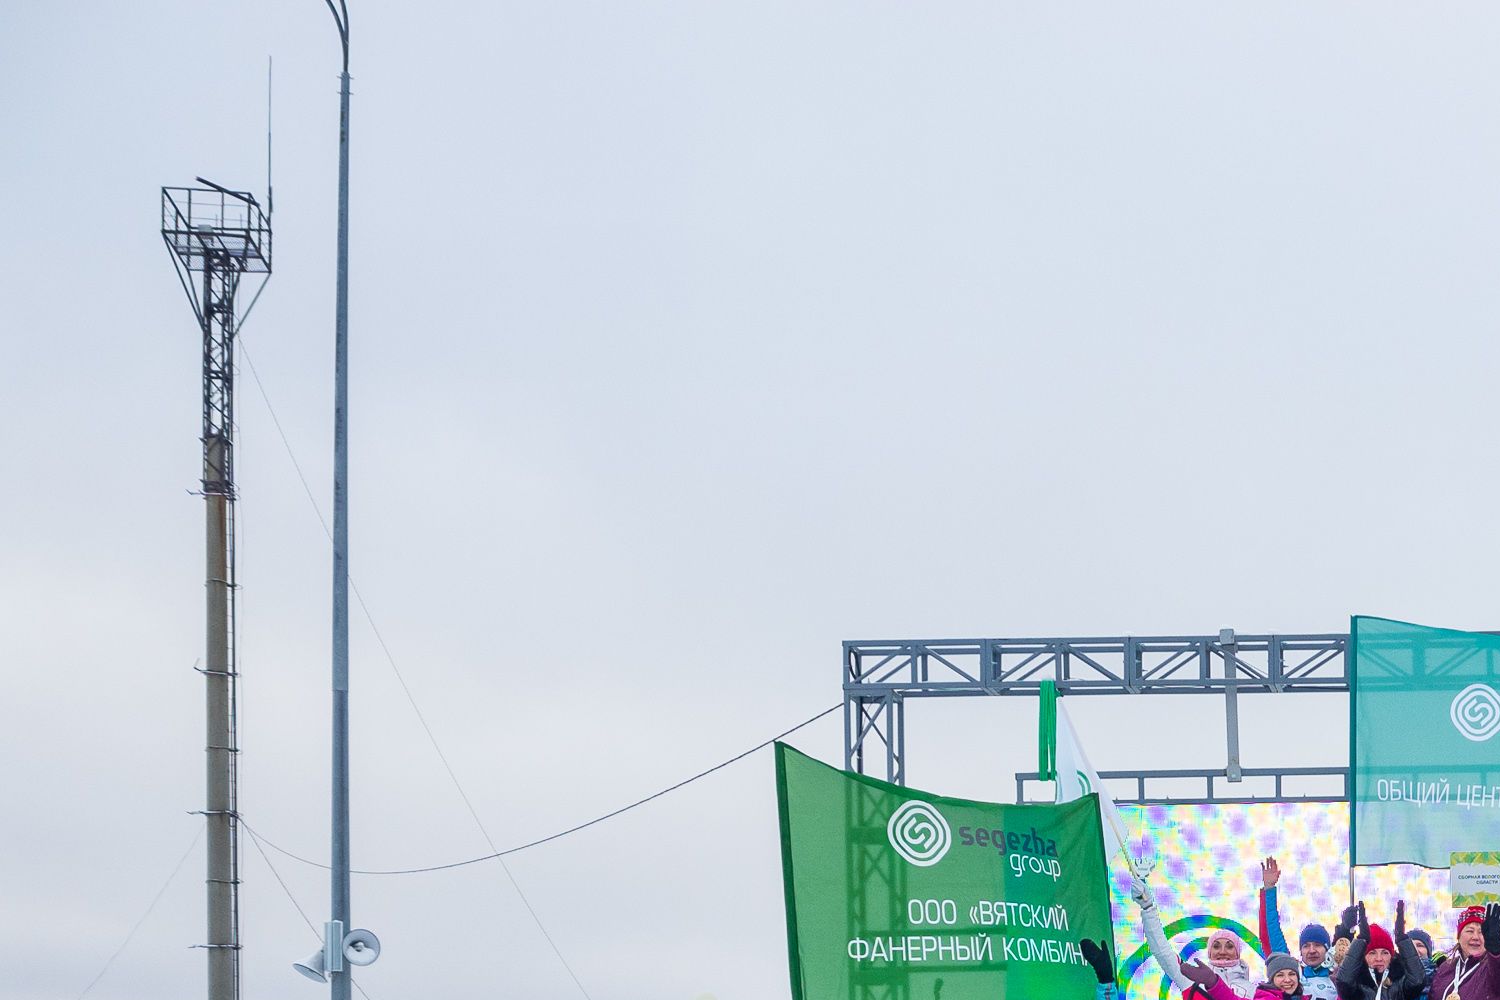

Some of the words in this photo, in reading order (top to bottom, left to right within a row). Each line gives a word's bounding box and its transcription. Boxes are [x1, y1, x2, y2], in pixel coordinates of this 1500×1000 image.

[1376, 777, 1449, 808] ОБЩИЙ
[958, 826, 1058, 858] segezha
[1009, 853, 1061, 882] group
[907, 899, 957, 924] ООО
[969, 900, 1069, 931] «ВЯТСКИЙ
[847, 932, 993, 963] ФАНЕРНЫЙ
[1002, 937, 1089, 966] КОМБИН
